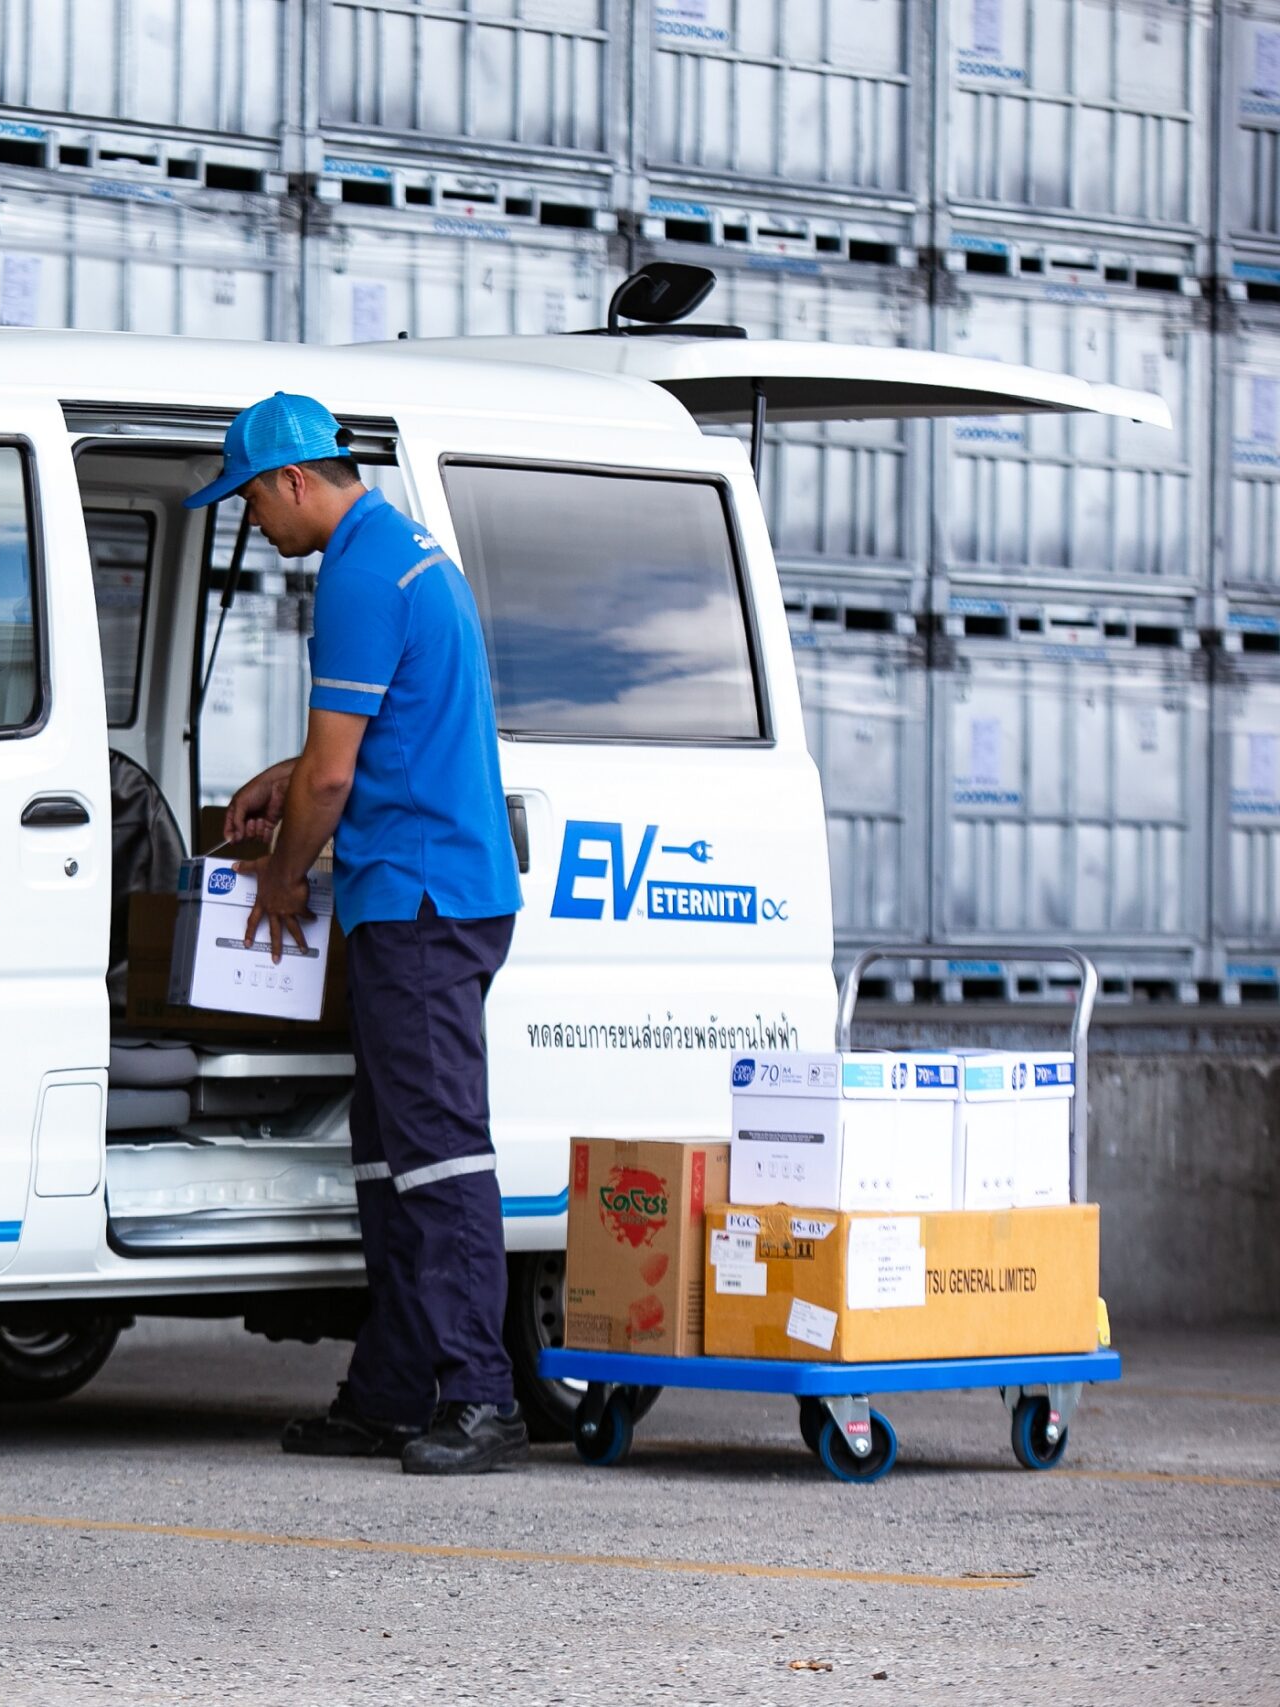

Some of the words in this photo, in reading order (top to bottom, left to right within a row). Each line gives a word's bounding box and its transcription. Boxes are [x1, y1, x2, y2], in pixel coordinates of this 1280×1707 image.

[210, 872, 233, 884] COPY
[550, 820, 660, 921] EV
[651, 886, 753, 919] ETERNITY
[760, 1064, 780, 1082] 70
[949, 1268, 996, 1294] GENERAL
[999, 1267, 1037, 1292] LIMITED
